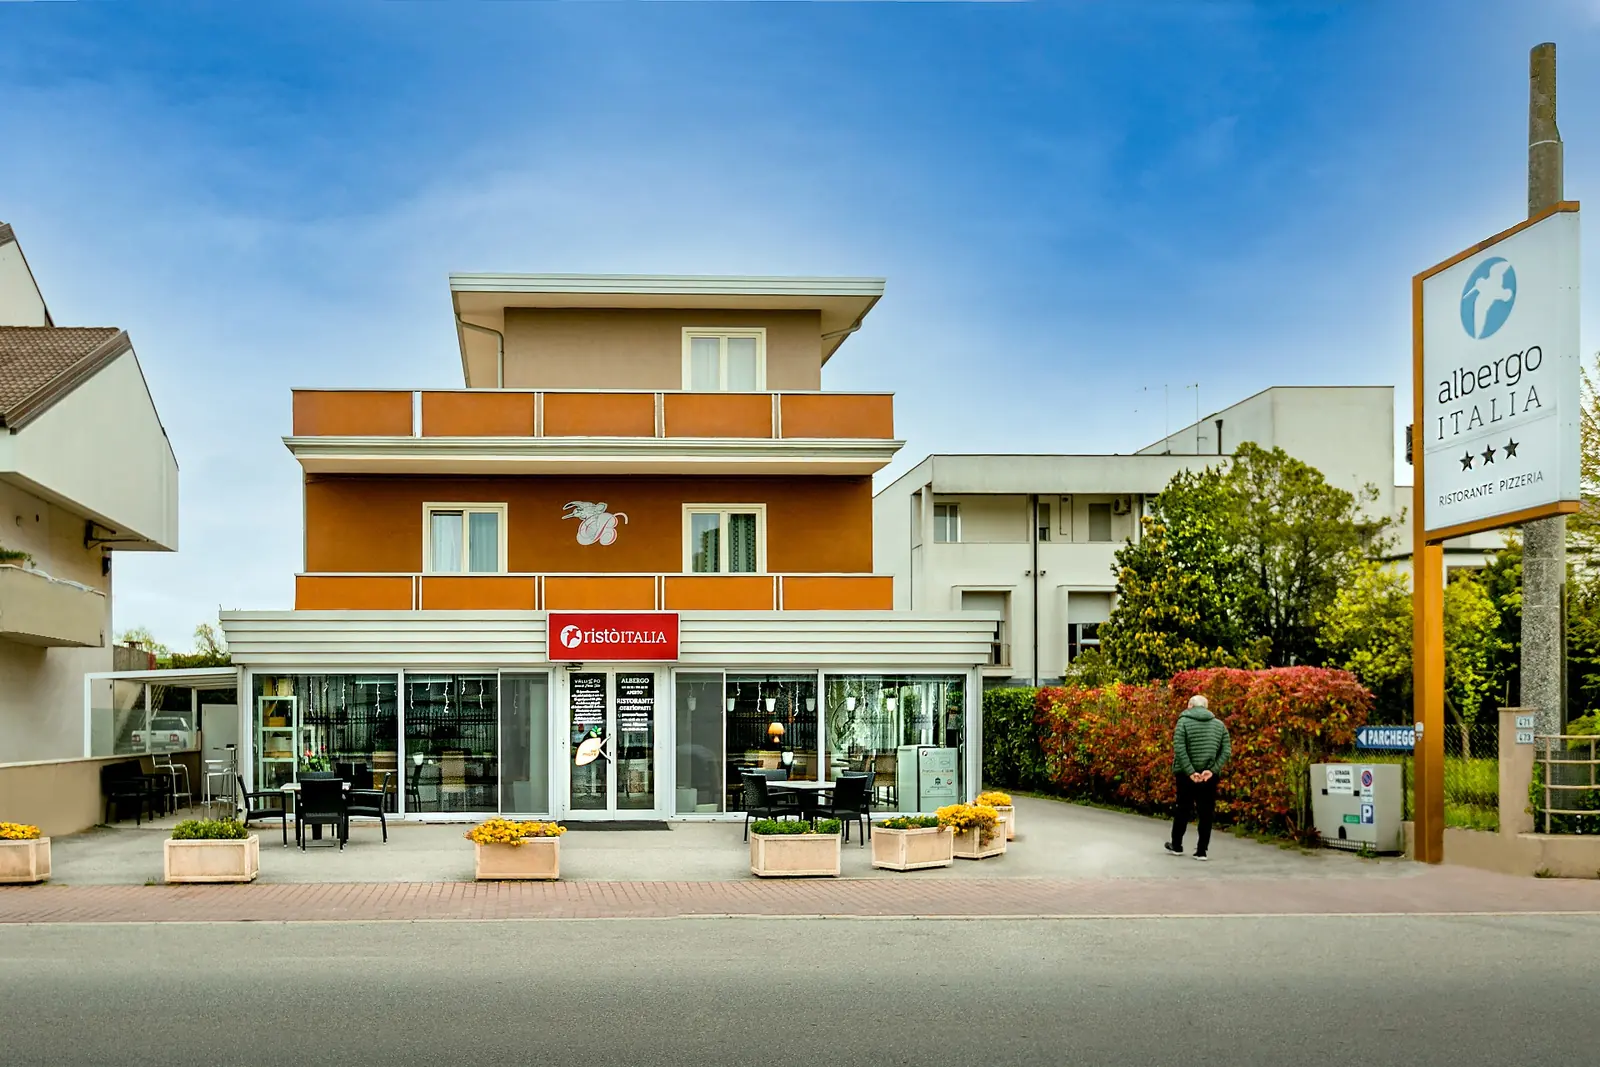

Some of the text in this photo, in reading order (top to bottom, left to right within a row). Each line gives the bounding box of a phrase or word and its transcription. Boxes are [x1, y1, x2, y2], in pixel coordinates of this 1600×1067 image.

[1438, 345, 1542, 404] albergo
[1438, 385, 1542, 440] ITALIA
[1439, 471, 1544, 507] RISTORANTE PIZZERIA
[1368, 729, 1416, 747] PARCHEGG
